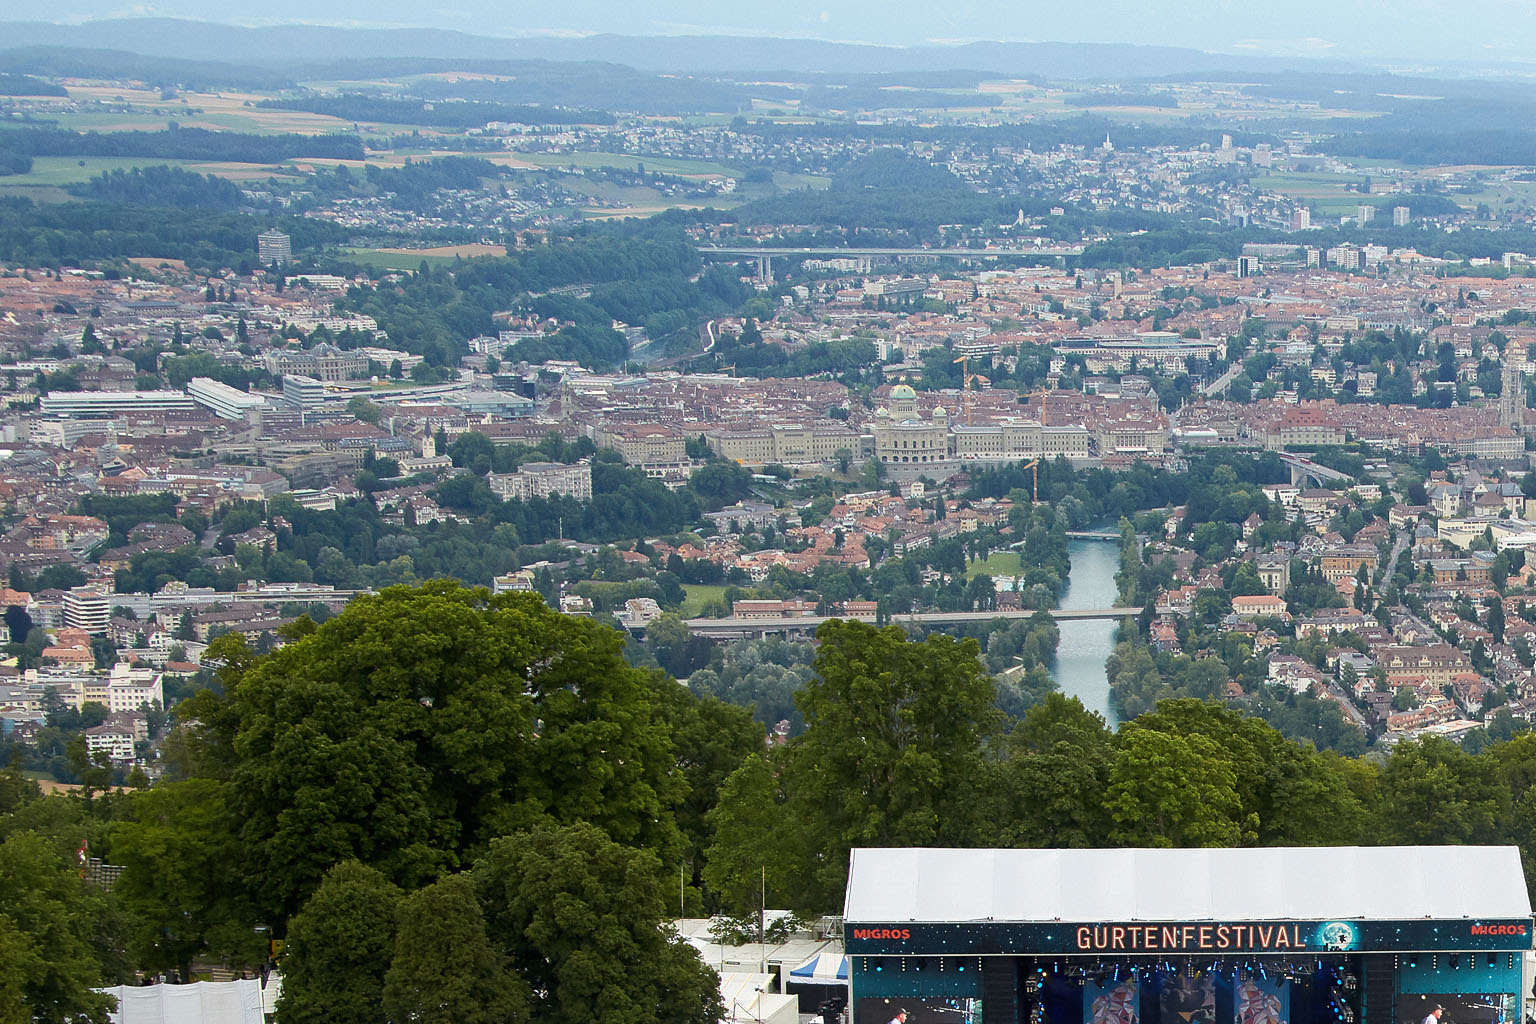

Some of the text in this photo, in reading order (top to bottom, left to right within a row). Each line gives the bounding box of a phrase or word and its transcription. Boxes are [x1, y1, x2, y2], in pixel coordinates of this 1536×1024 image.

[853, 928, 911, 940] MIGROS
[1471, 924, 1526, 936] MIGROS
[1076, 925, 1306, 949] GURTENFESTIVAL
